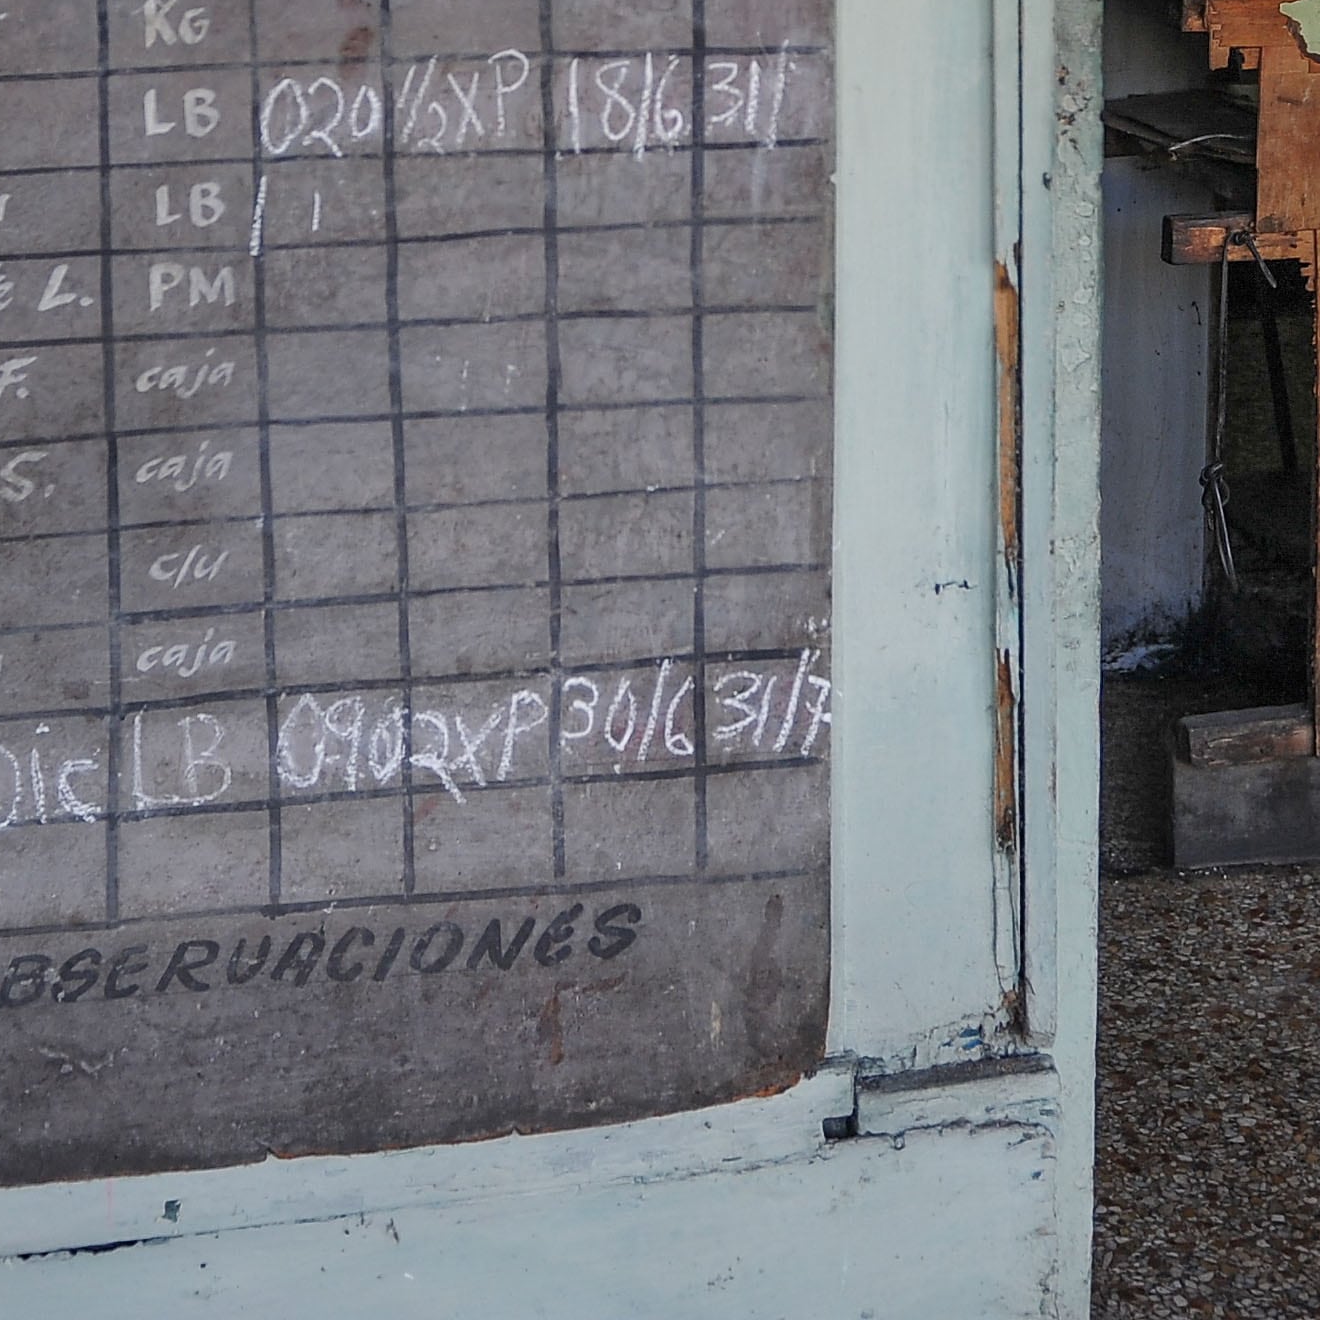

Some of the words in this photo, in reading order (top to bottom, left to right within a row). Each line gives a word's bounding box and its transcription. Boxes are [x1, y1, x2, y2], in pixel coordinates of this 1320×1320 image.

[142, 88, 221, 139] LB
[154, 181, 228, 227] LB
[147, 264, 237, 312] PM
[134, 349, 235, 399] caja
[134, 440, 234, 493] caja
[136, 628, 237, 679] caja
